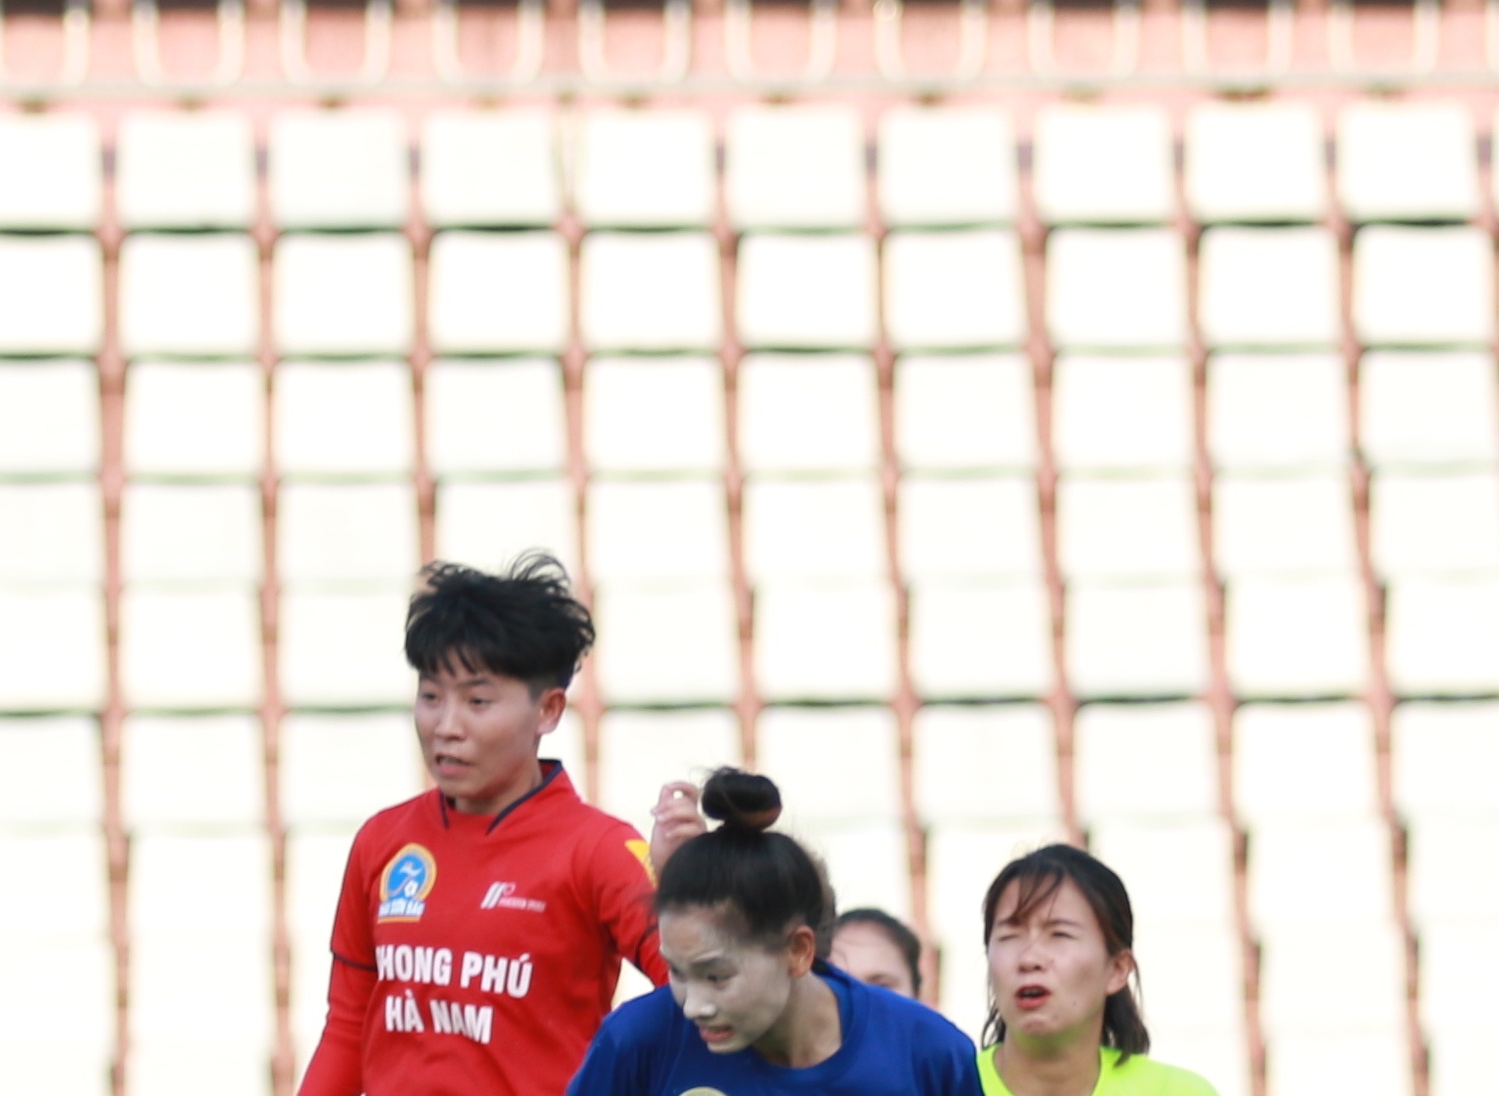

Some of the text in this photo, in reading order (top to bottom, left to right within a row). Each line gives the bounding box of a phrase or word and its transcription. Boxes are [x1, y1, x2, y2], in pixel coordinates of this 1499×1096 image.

[460, 951, 533, 998] PHÚ
[385, 988, 494, 1045] HÀ NAM
